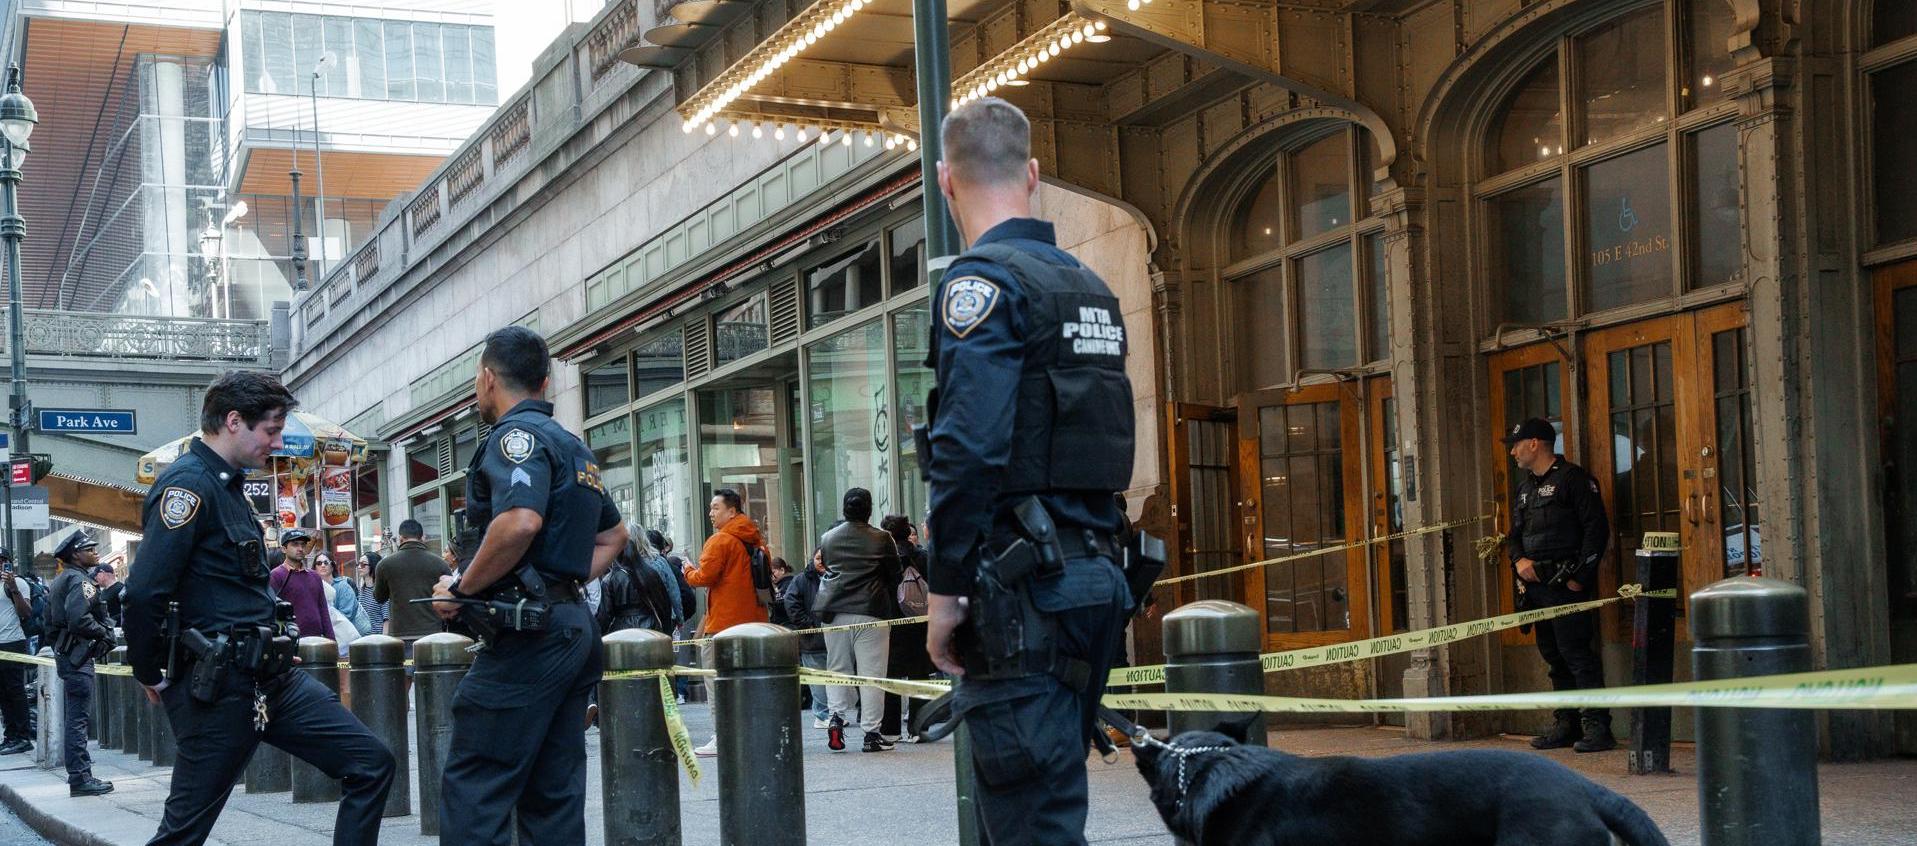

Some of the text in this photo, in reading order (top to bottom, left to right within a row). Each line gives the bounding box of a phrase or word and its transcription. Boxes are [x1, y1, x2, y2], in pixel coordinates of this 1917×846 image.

[1592, 248, 1611, 266] 105
[1615, 245, 1623, 261] E
[1626, 238, 1652, 257] 42nd
[950, 280, 993, 298] POLICE
[1079, 306, 1112, 325] MTA
[1063, 322, 1124, 342] POLICE
[56, 415, 119, 428] Park Ave
[504, 431, 530, 446] POLICE
[167, 490, 197, 507] POLICE
